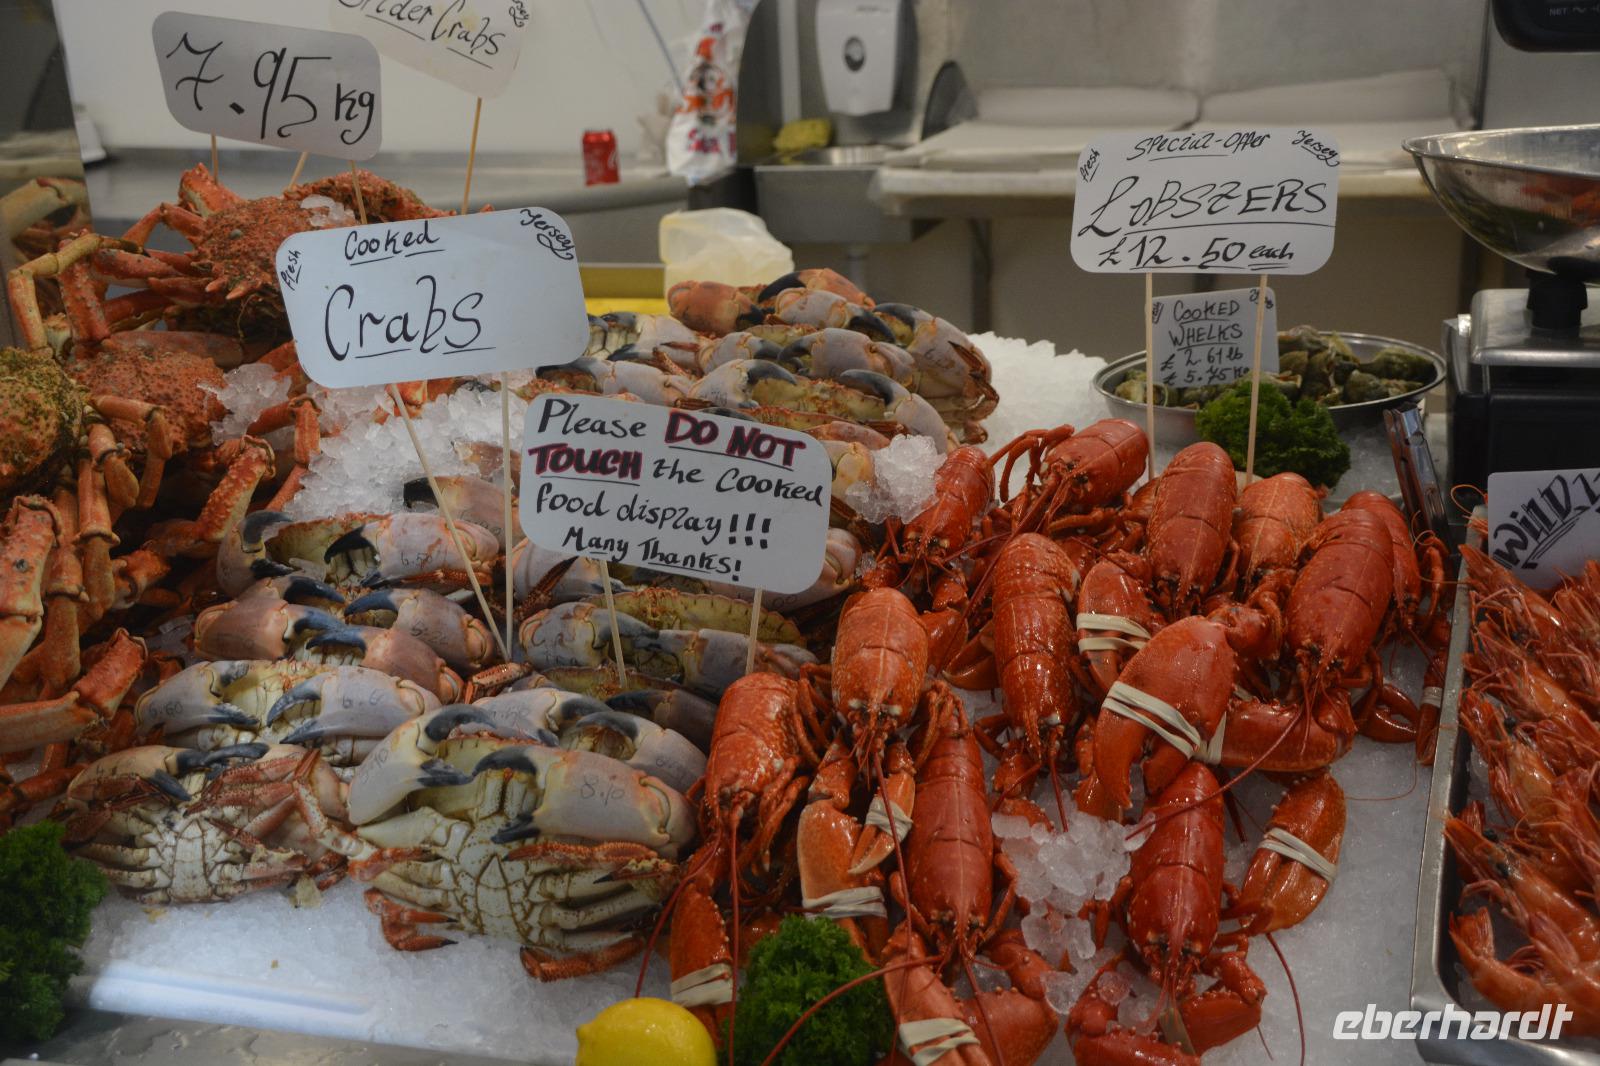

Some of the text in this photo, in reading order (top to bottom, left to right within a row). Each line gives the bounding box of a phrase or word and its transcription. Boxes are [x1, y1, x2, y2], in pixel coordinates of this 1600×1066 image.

[431, 0, 506, 56] Crabs
[345, 220, 440, 261] Cooked
[520, 208, 575, 260] Jersey
[1248, 242, 1293, 261] each
[324, 275, 484, 361] Crabs
[1169, 323, 1243, 347] WHELKS
[1226, 347, 1244, 361] lb
[538, 399, 807, 467] Please DO NOT
[528, 442, 823, 507] TOUCH the Cooked
[537, 483, 610, 516] food
[562, 526, 742, 582] Many Thanks!
